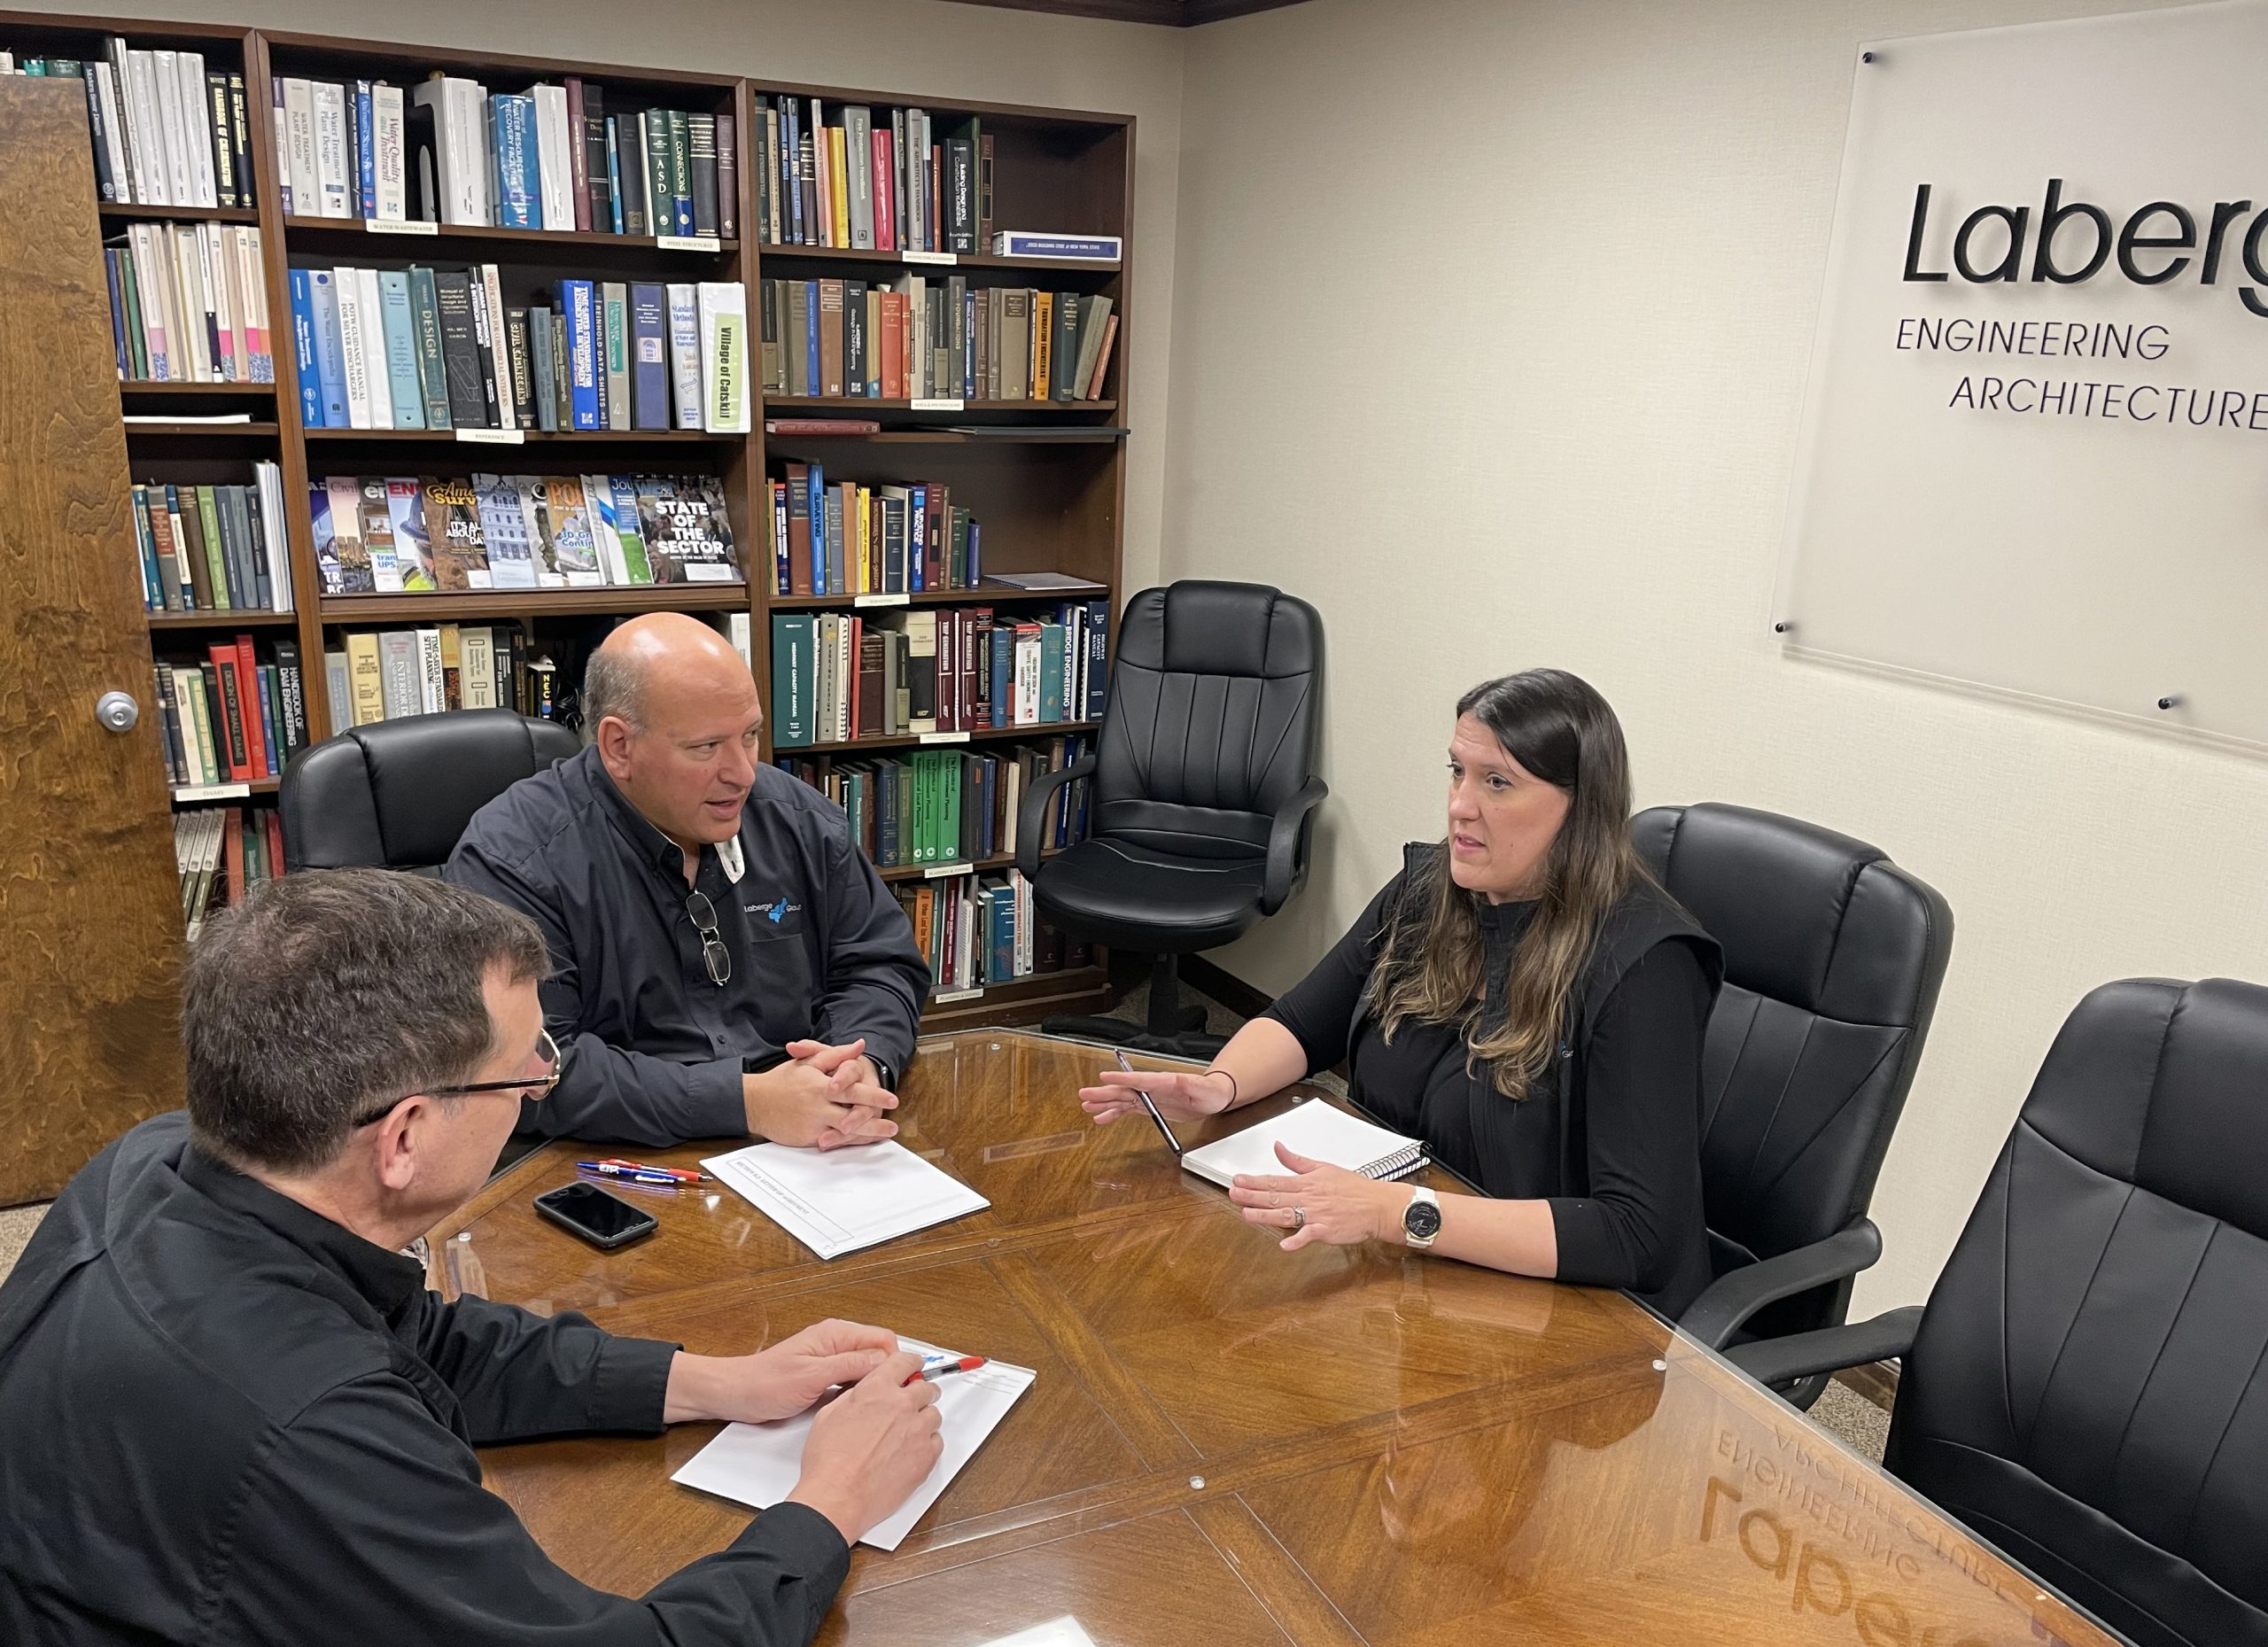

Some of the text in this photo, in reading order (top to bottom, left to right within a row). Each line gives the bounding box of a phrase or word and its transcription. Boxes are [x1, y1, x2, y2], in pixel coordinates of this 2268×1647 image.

[301, 113, 312, 175] WATER TREATMENT
[321, 135, 331, 164] Design
[332, 137, 342, 180] Treatment
[381, 116, 391, 182] and Treatment
[390, 118, 401, 184] Water Quality
[514, 104, 524, 174] WATER RESOURCE
[508, 146, 518, 186] FACILITIES
[676, 141, 687, 192] CONNECTIONS
[959, 164, 967, 188] Building
[478, 283, 486, 308] HUMAN
[342, 320, 352, 346] SILVER
[423, 309, 438, 359] DESIGN
[510, 322, 521, 347] CIVIL
[673, 313, 695, 322] Methods
[1895, 317, 2171, 361] ENGINEERING
[348, 302, 367, 402] POTW GUIDANCE MANUAL
[595, 305, 608, 408] REINHOLD DATA SHEETS
[1039, 307, 1049, 379] FOUNDATION ENGINEERING
[344, 347, 359, 401] DISCHARGERS
[512, 347, 527, 407] ENGINEERING
[719, 327, 732, 419] Village of Catskill
[1948, 376, 2268, 431] ARCHITECTURE
[330, 481, 359, 493] Civil
[656, 501, 710, 516] STATE
[446, 529, 478, 538] ABOUT
[671, 527, 706, 540] THE
[673, 514, 695, 528] OF
[656, 540, 726, 555] SECTOR
[424, 651, 435, 685] PLANNING
[431, 635, 441, 676] TIME-SAVER
[290, 666, 305, 730] HANDBOOK OF
[397, 662, 409, 705] INTERIOR
[1063, 655, 1072, 708] ENGINEERING
[224, 670, 244, 759] DESIGN OF SMALL DAMS
[280, 668, 297, 747] DAM ENGINEERING
[744, 903, 773, 913] Laberge
